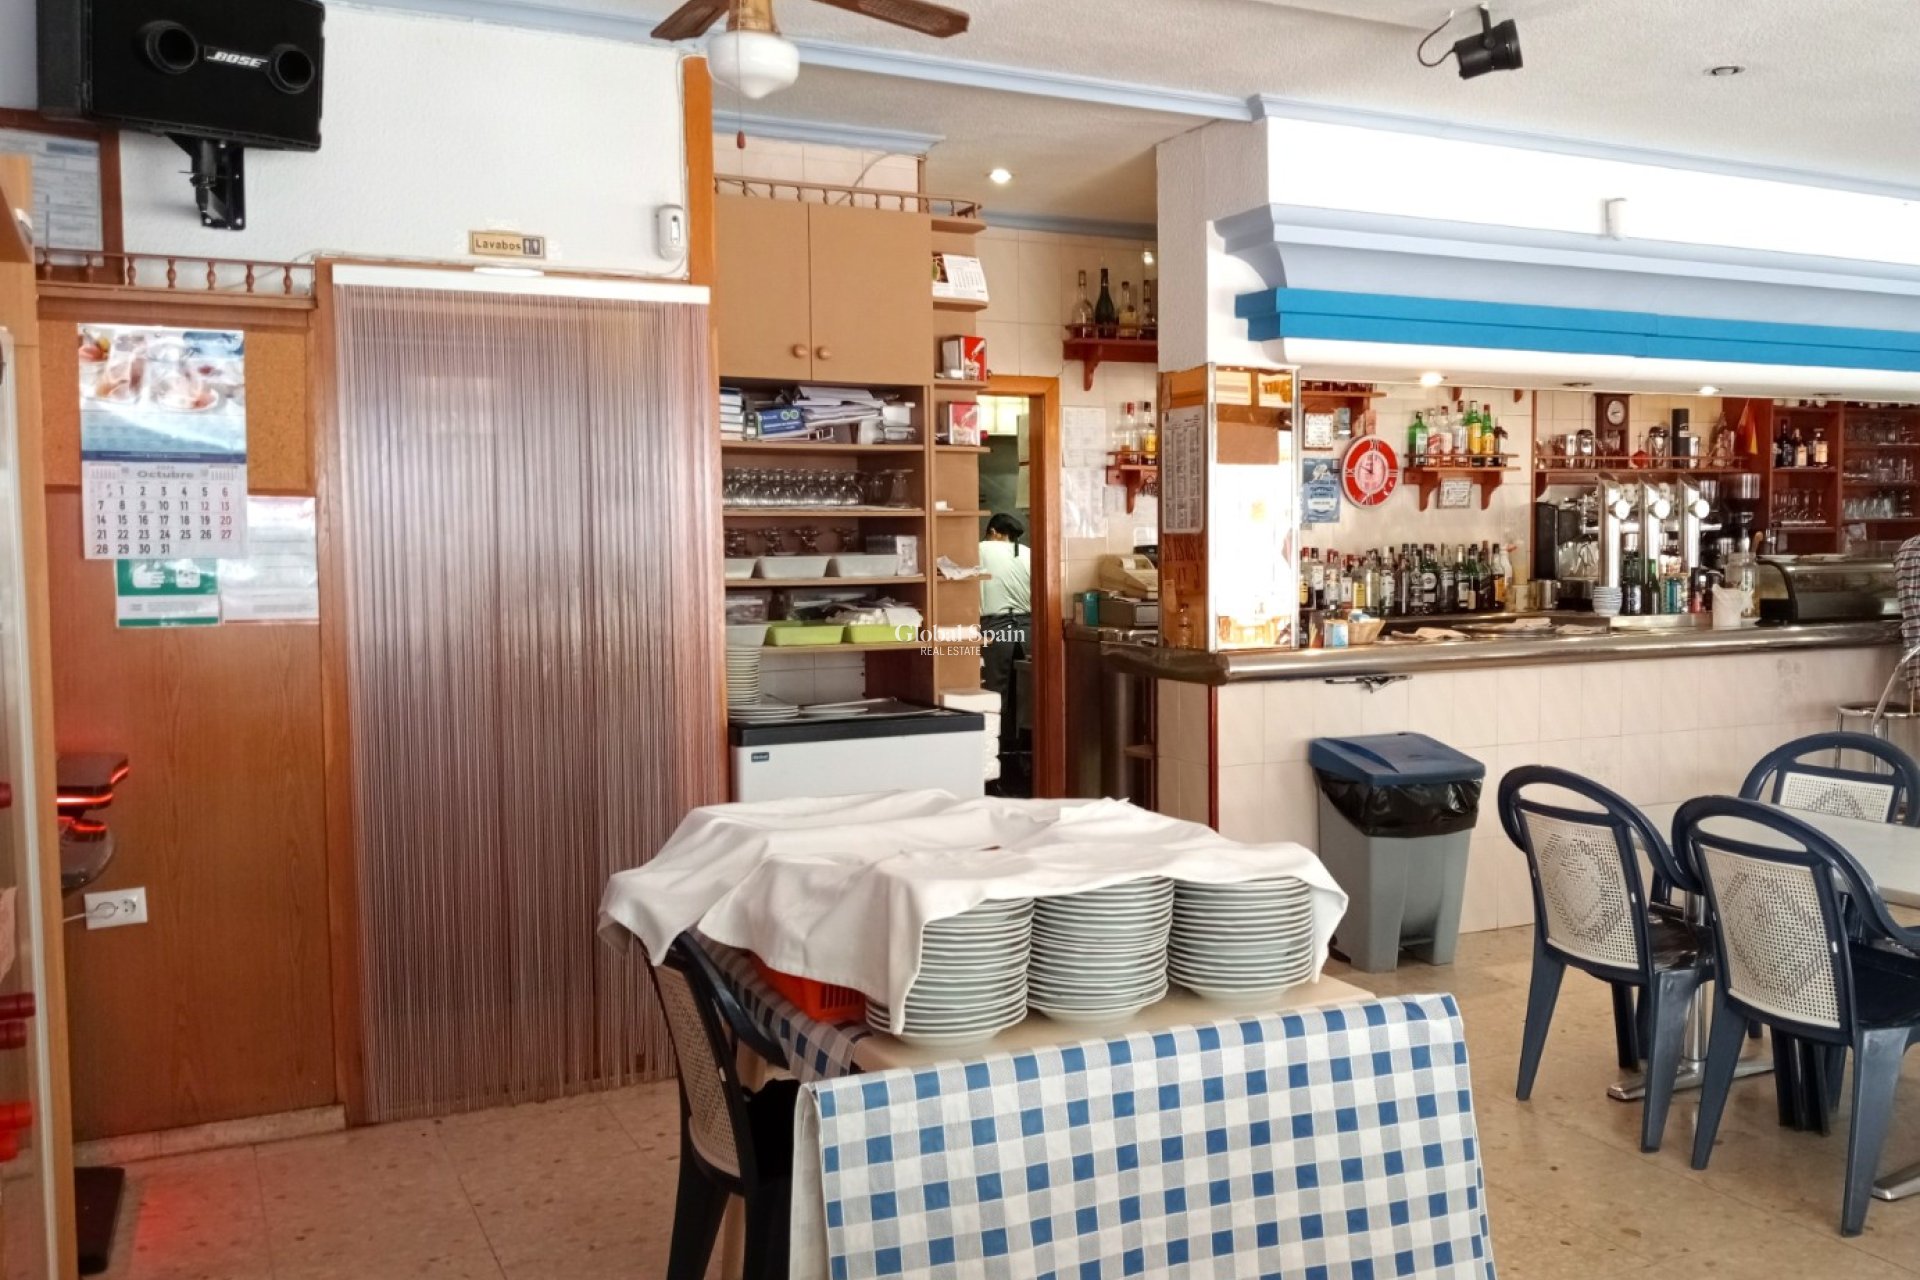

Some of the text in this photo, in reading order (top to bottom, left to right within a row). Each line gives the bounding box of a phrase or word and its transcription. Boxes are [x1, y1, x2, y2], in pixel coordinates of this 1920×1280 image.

[206, 51, 268, 68] BOSE
[475, 238, 521, 250] Lavabos
[137, 470, 193, 479] Octubre
[120, 485, 229, 498] 1 2 3 4 5 6
[98, 500, 104, 511] 7
[119, 500, 126, 510] 8
[140, 500, 147, 511] 9
[159, 500, 169, 511] 10
[180, 500, 189, 511] 11
[200, 501, 210, 511] 12
[97, 514, 232, 525] 14 15 16 17 18 19 20
[97, 529, 232, 540] 21 22 23 24 25 26 27
[96, 543, 170, 556] 28 29 30 31
